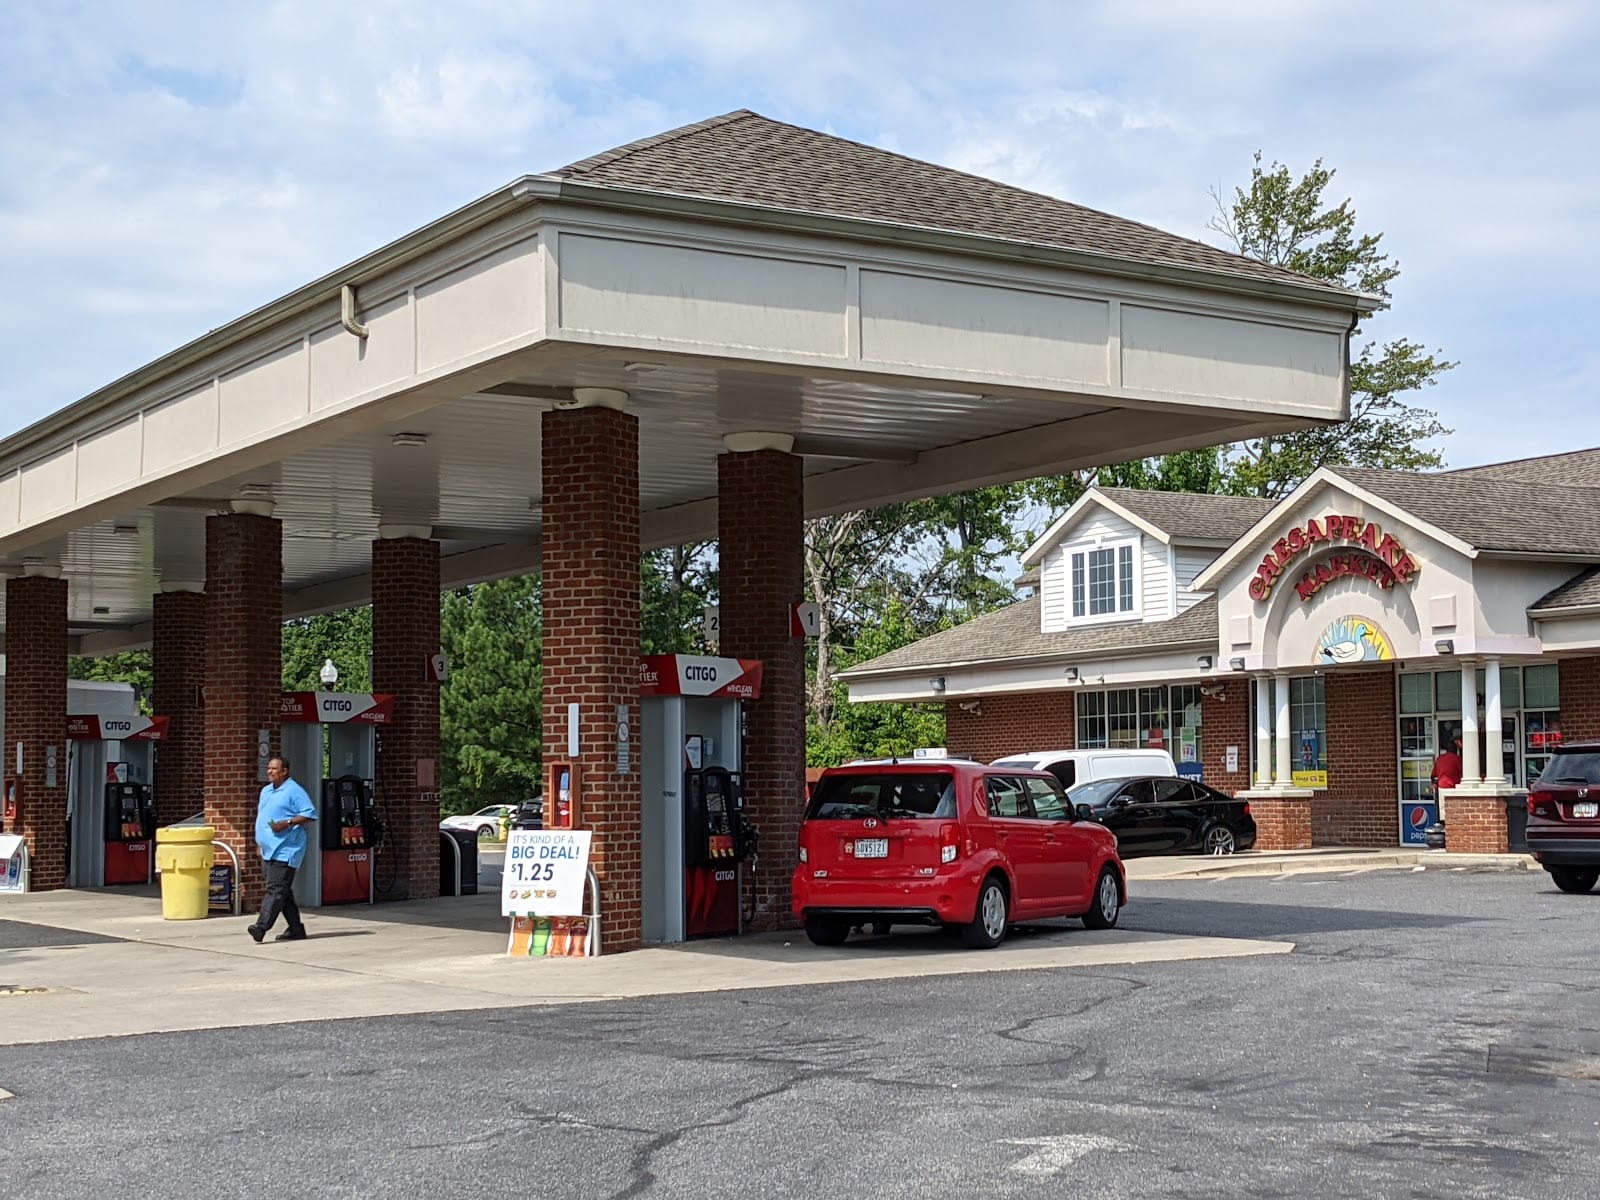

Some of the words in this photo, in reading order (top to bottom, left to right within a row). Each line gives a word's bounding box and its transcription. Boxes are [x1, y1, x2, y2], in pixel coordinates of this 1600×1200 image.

[1248, 515, 1419, 601] CHESAPEAKE
[1295, 553, 1397, 602] MARKET
[710, 616, 718, 630] 2
[807, 612, 814, 626] 1
[438, 661, 444, 672] 3
[685, 665, 717, 681] CITGO
[323, 699, 352, 712] CITGO
[105, 721, 131, 731] CITGO
[513, 835, 527, 844] IT'S
[529, 835, 551, 844] KIND
[553, 836, 566, 844] OF
[567, 836, 574, 844] A
[348, 853, 367, 861] CITGO
[511, 846, 535, 859] BIG
[540, 846, 580, 859] DEAL!
[511, 863, 554, 881] $1.25
[715, 870, 735, 881] CITGO
